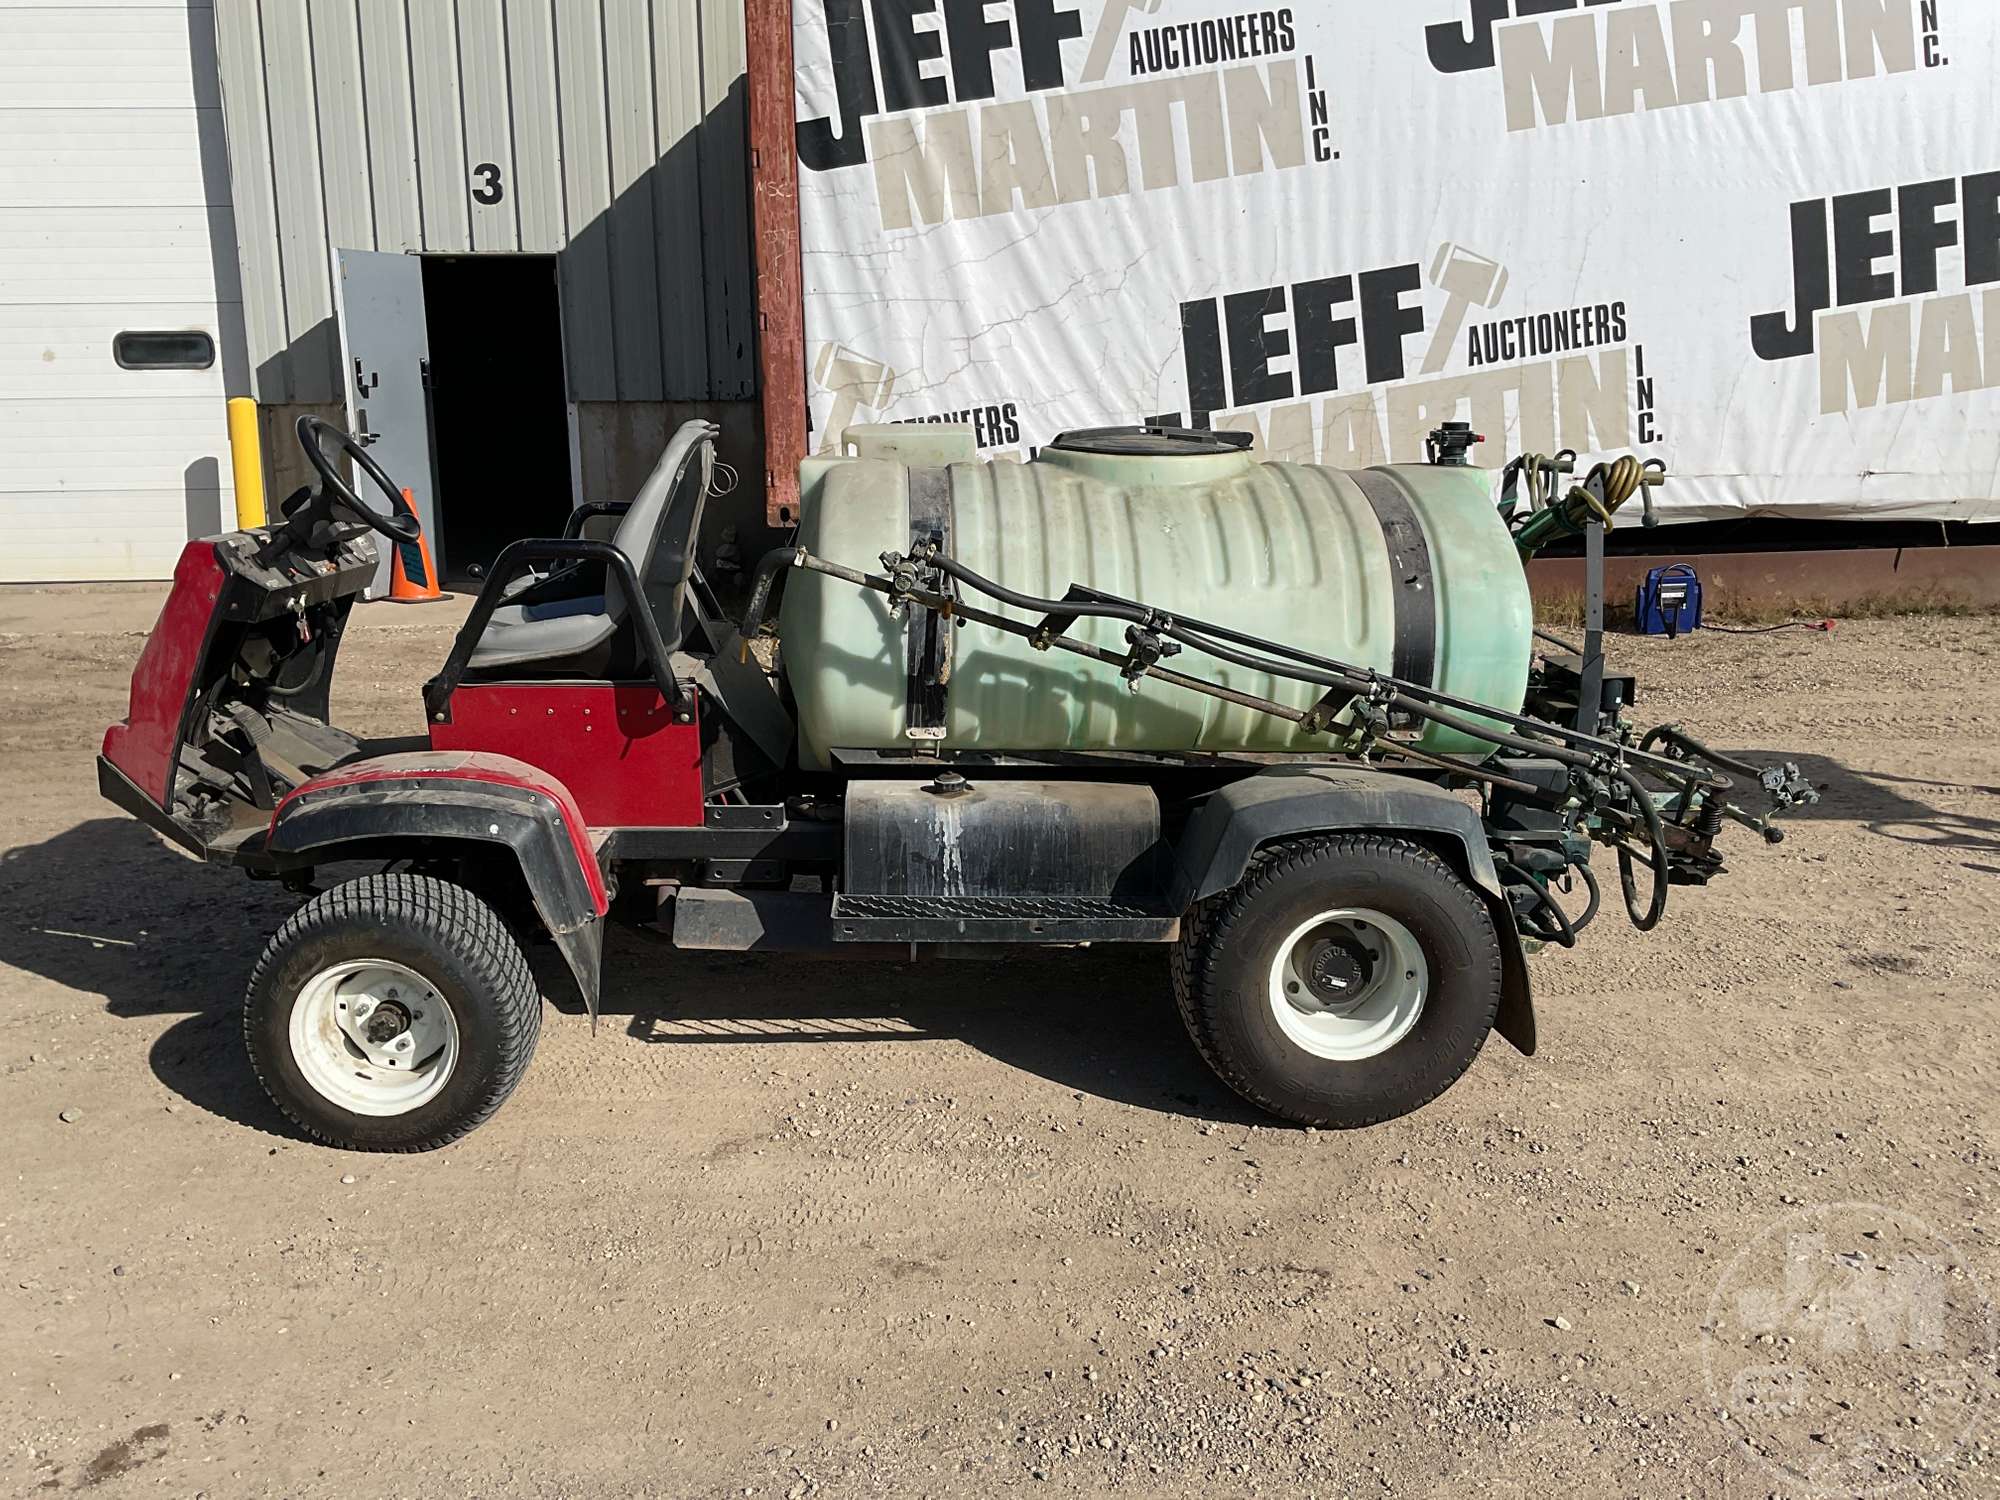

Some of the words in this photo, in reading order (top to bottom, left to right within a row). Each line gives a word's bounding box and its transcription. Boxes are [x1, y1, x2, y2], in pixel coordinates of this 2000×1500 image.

[796, 0, 1083, 172] JEFF
[1129, 8, 1296, 76] AUCTIONEERS
[1498, 0, 1916, 132] MARTIN
[867, 59, 1306, 231] MARTIN
[1305, 54, 1340, 163] INC.
[472, 163, 504, 206] 3
[1144, 263, 1424, 430] JEFF
[1468, 301, 1626, 367] AUCTIONEERS
[1818, 288, 2000, 416] MA
[1635, 345, 1663, 444] INC.
